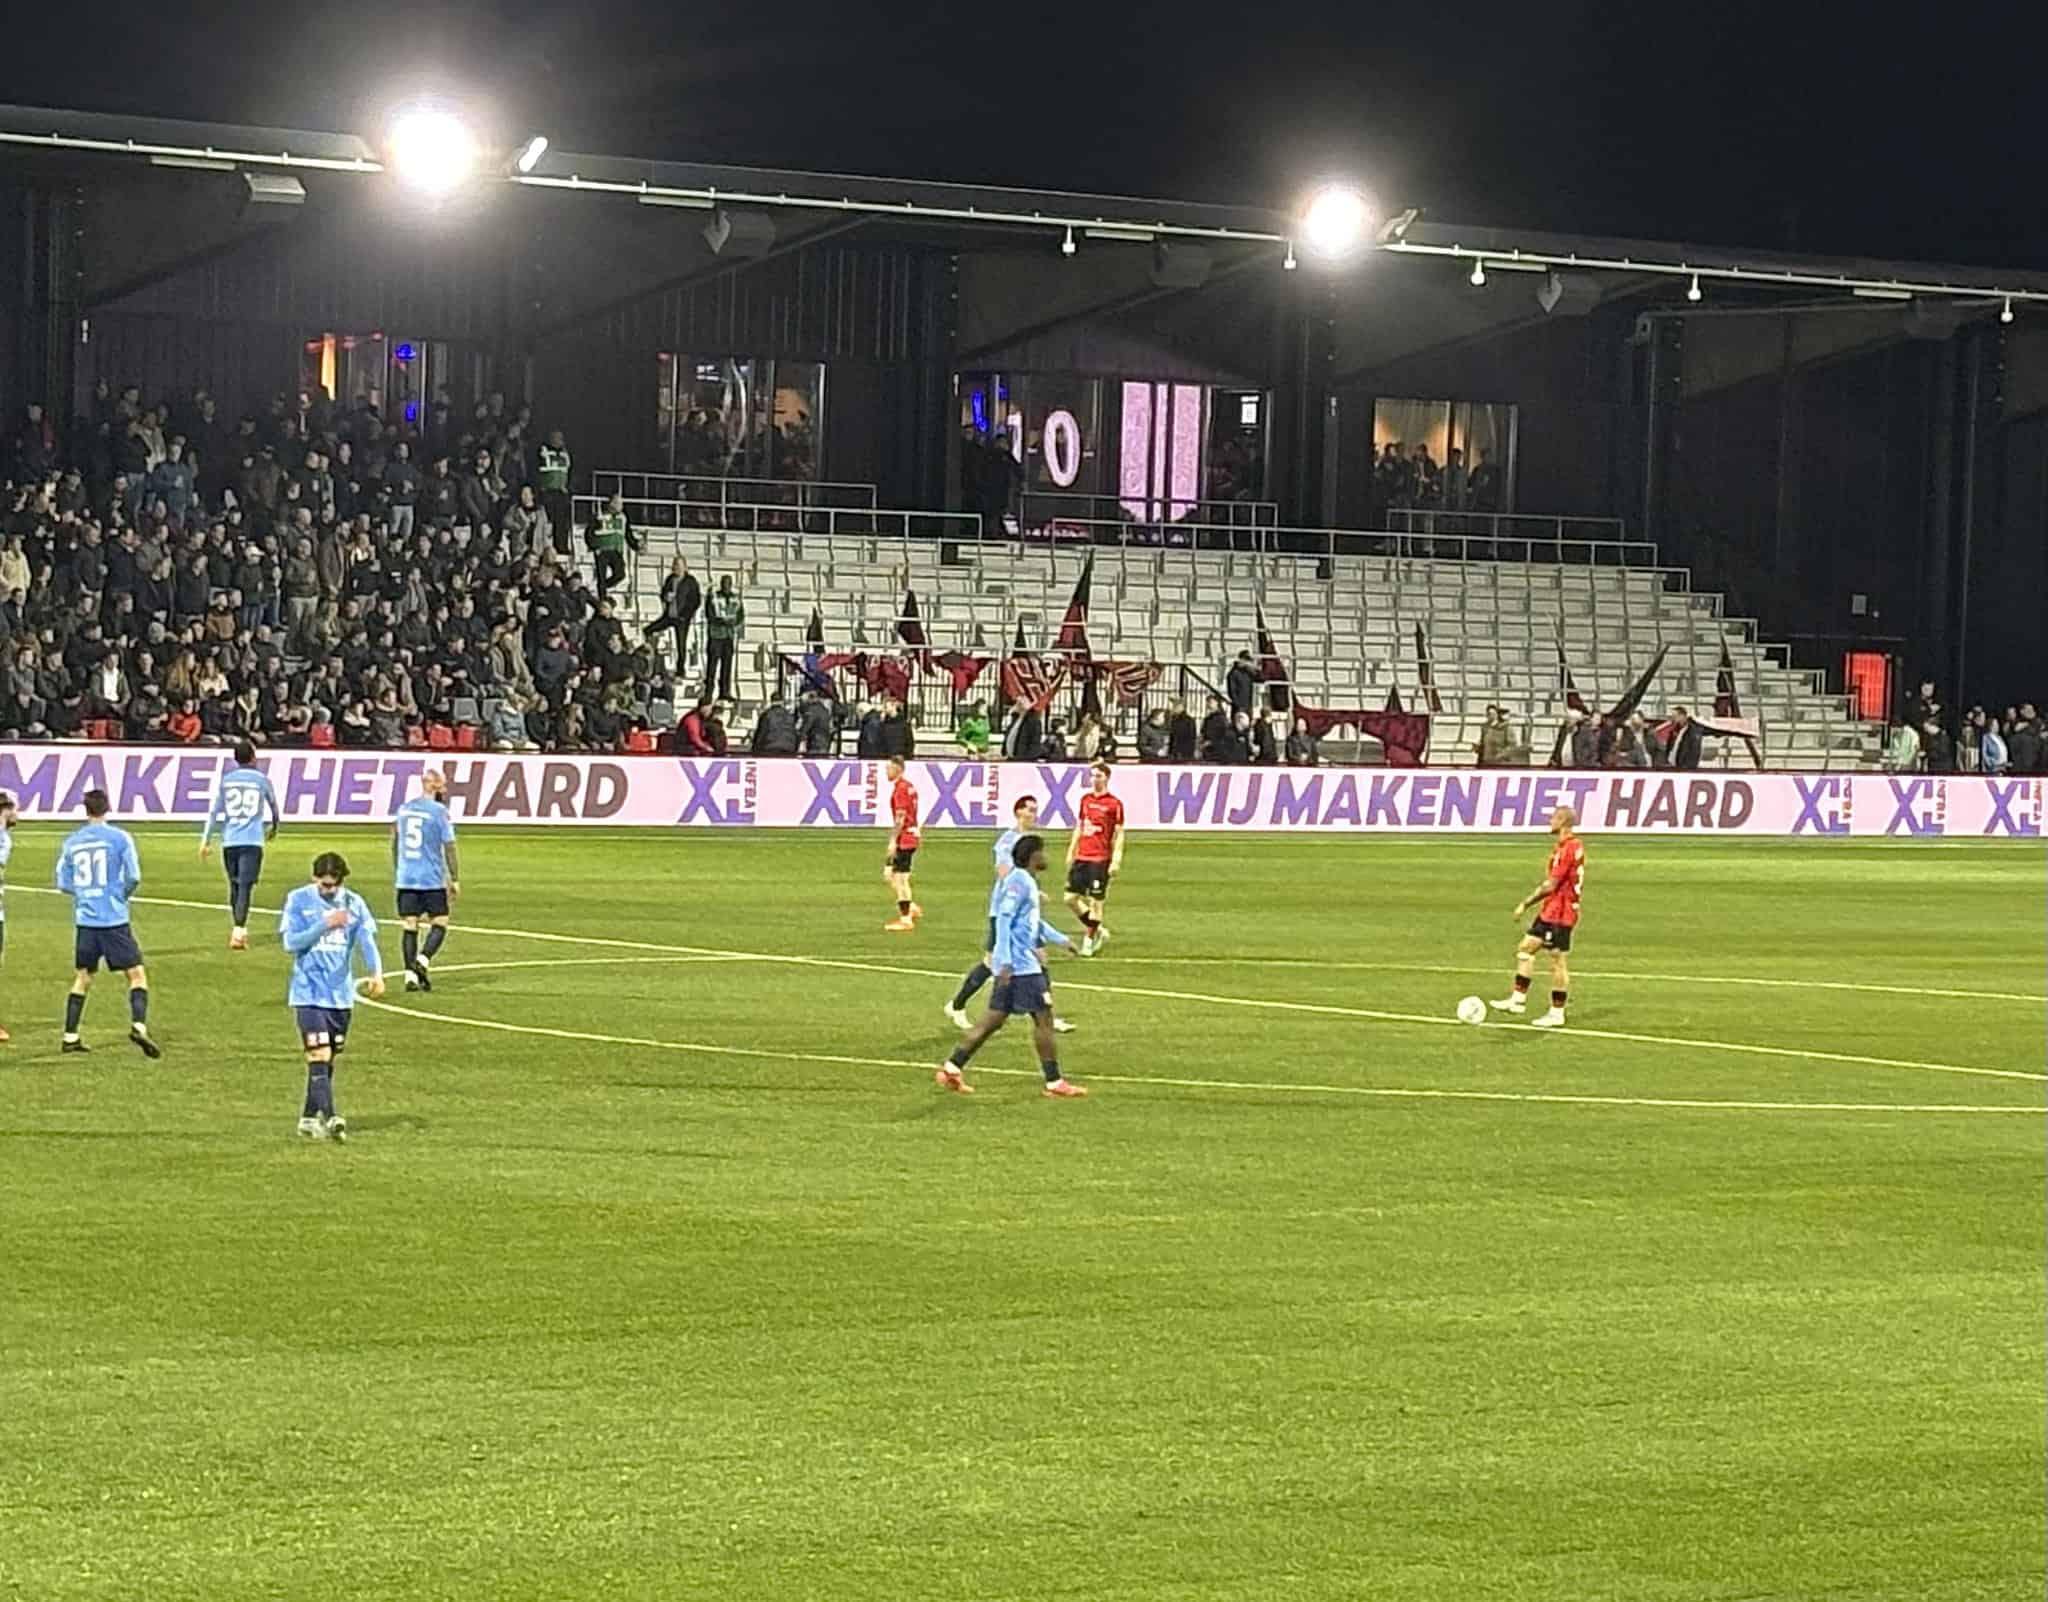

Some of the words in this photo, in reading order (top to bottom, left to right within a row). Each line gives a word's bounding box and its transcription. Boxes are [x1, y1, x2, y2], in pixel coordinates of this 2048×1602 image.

[225, 788, 260, 817] 29
[283, 757, 425, 816] HET
[440, 760, 629, 818] HARD
[1157, 772, 1263, 824] WIJ
[1270, 774, 1482, 826] MAKEN
[1490, 777, 1599, 827] HET
[1604, 778, 1754, 828] HARD
[404, 817, 423, 849] 5
[73, 848, 108, 887] 31
